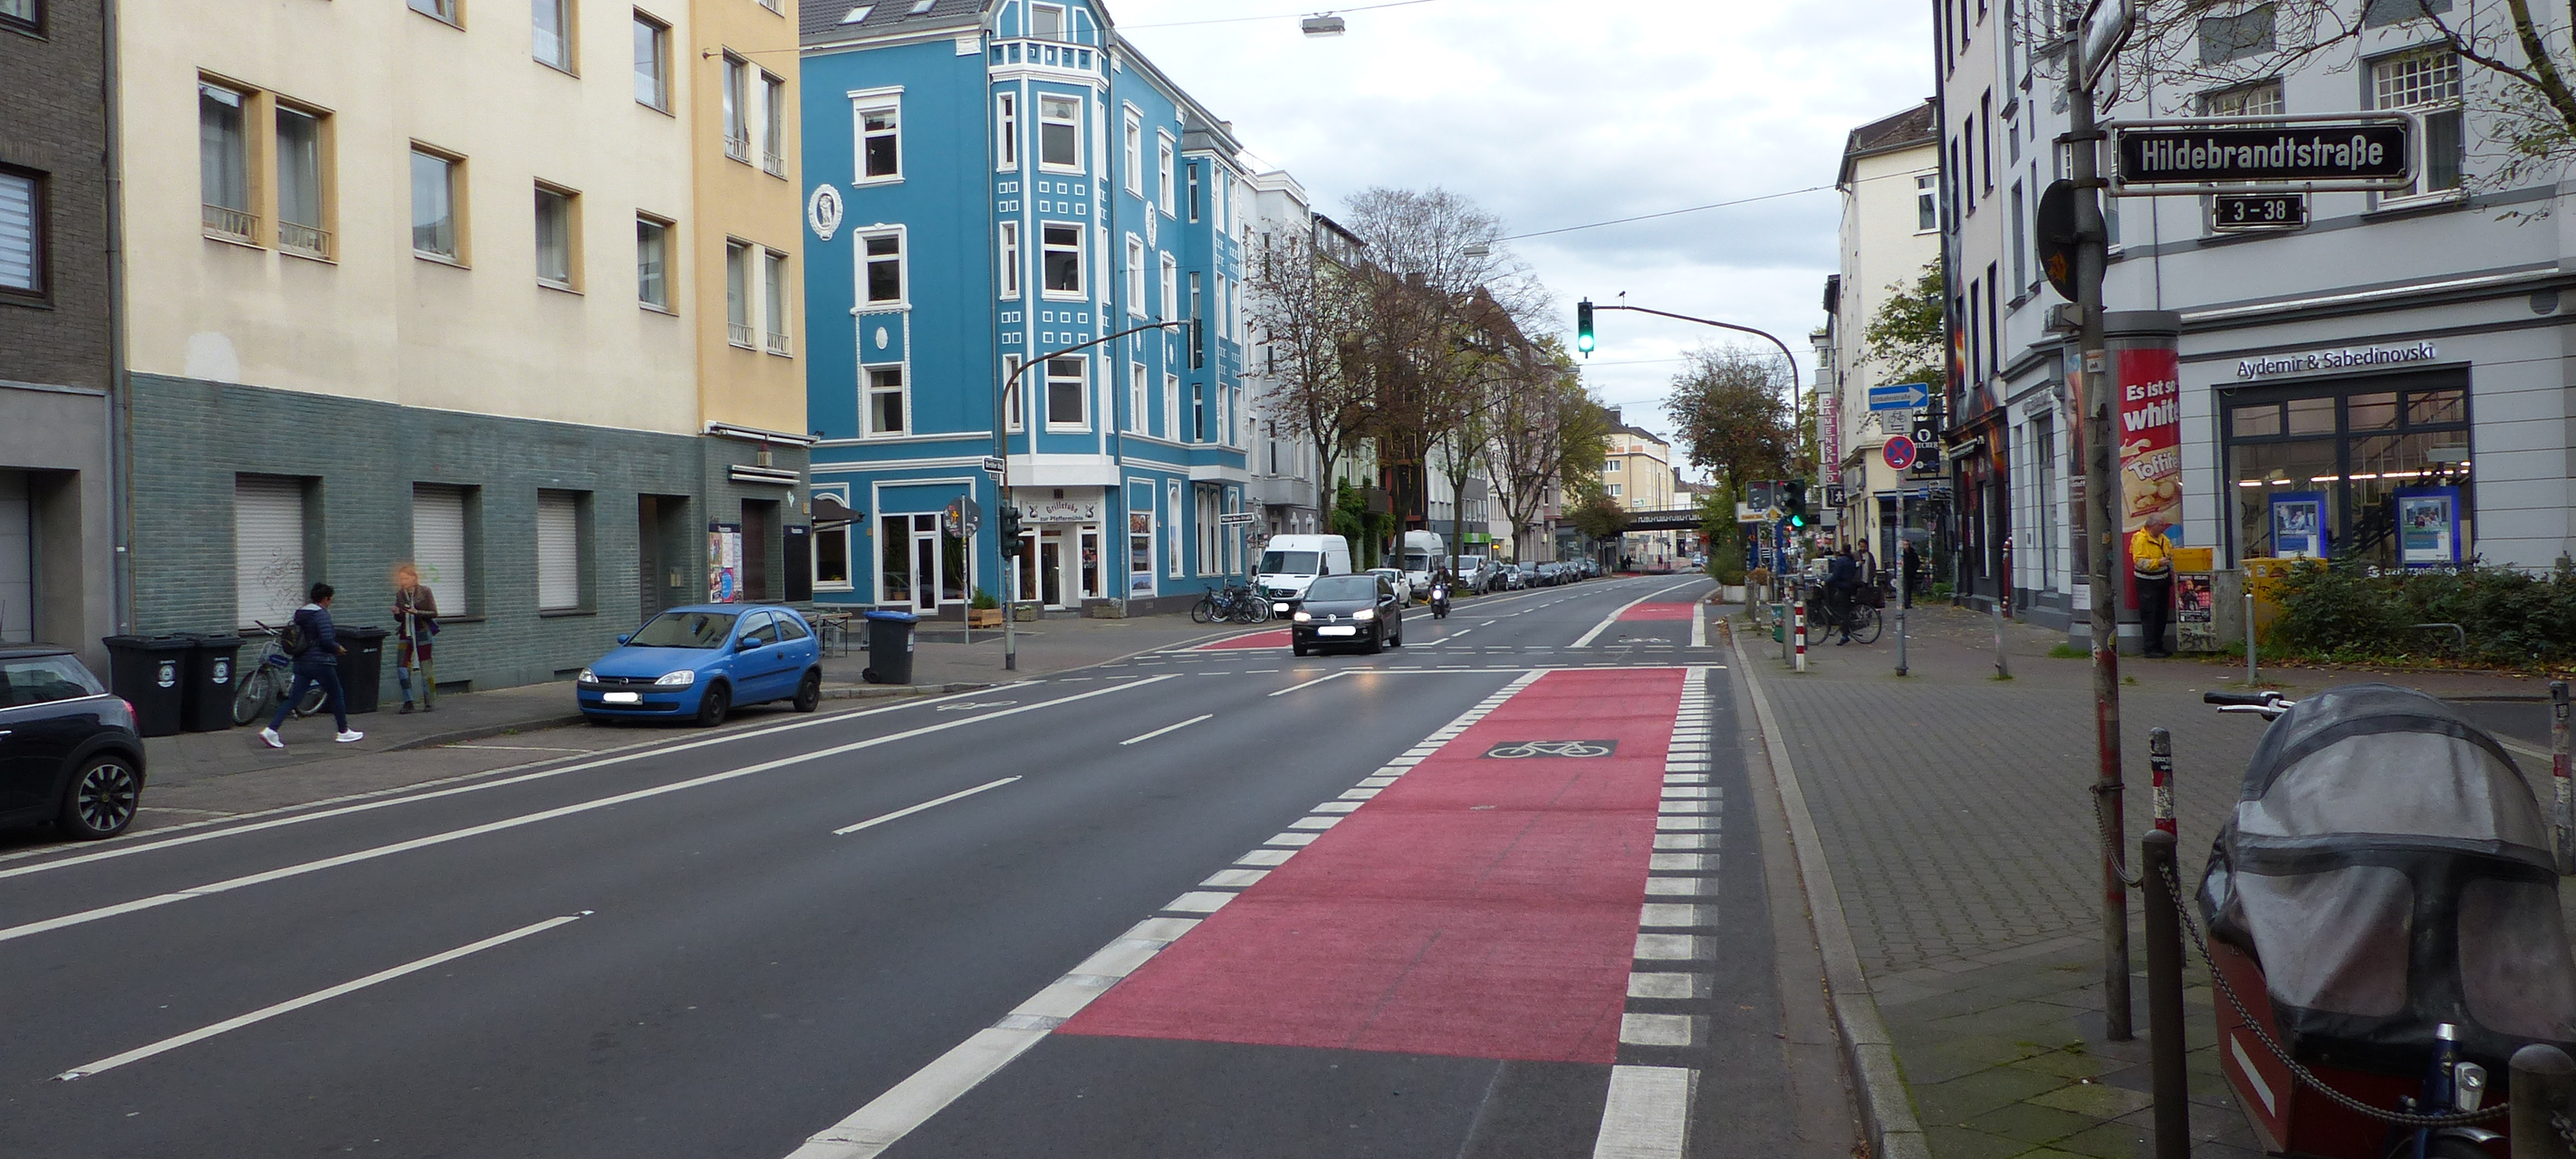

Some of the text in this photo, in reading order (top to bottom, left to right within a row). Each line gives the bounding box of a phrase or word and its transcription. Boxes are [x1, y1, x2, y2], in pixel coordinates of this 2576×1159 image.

[2142, 135, 2383, 171] Hildebrandtstraße
[2233, 200, 2244, 221] 3
[2263, 200, 2286, 220] 38
[2237, 342, 2436, 380] Aydemir & Sabedinovski
[2127, 379, 2176, 401] Es ist so
[1823, 398, 1834, 483] DAMENSALO
[1045, 501, 1079, 513] Grillstube
